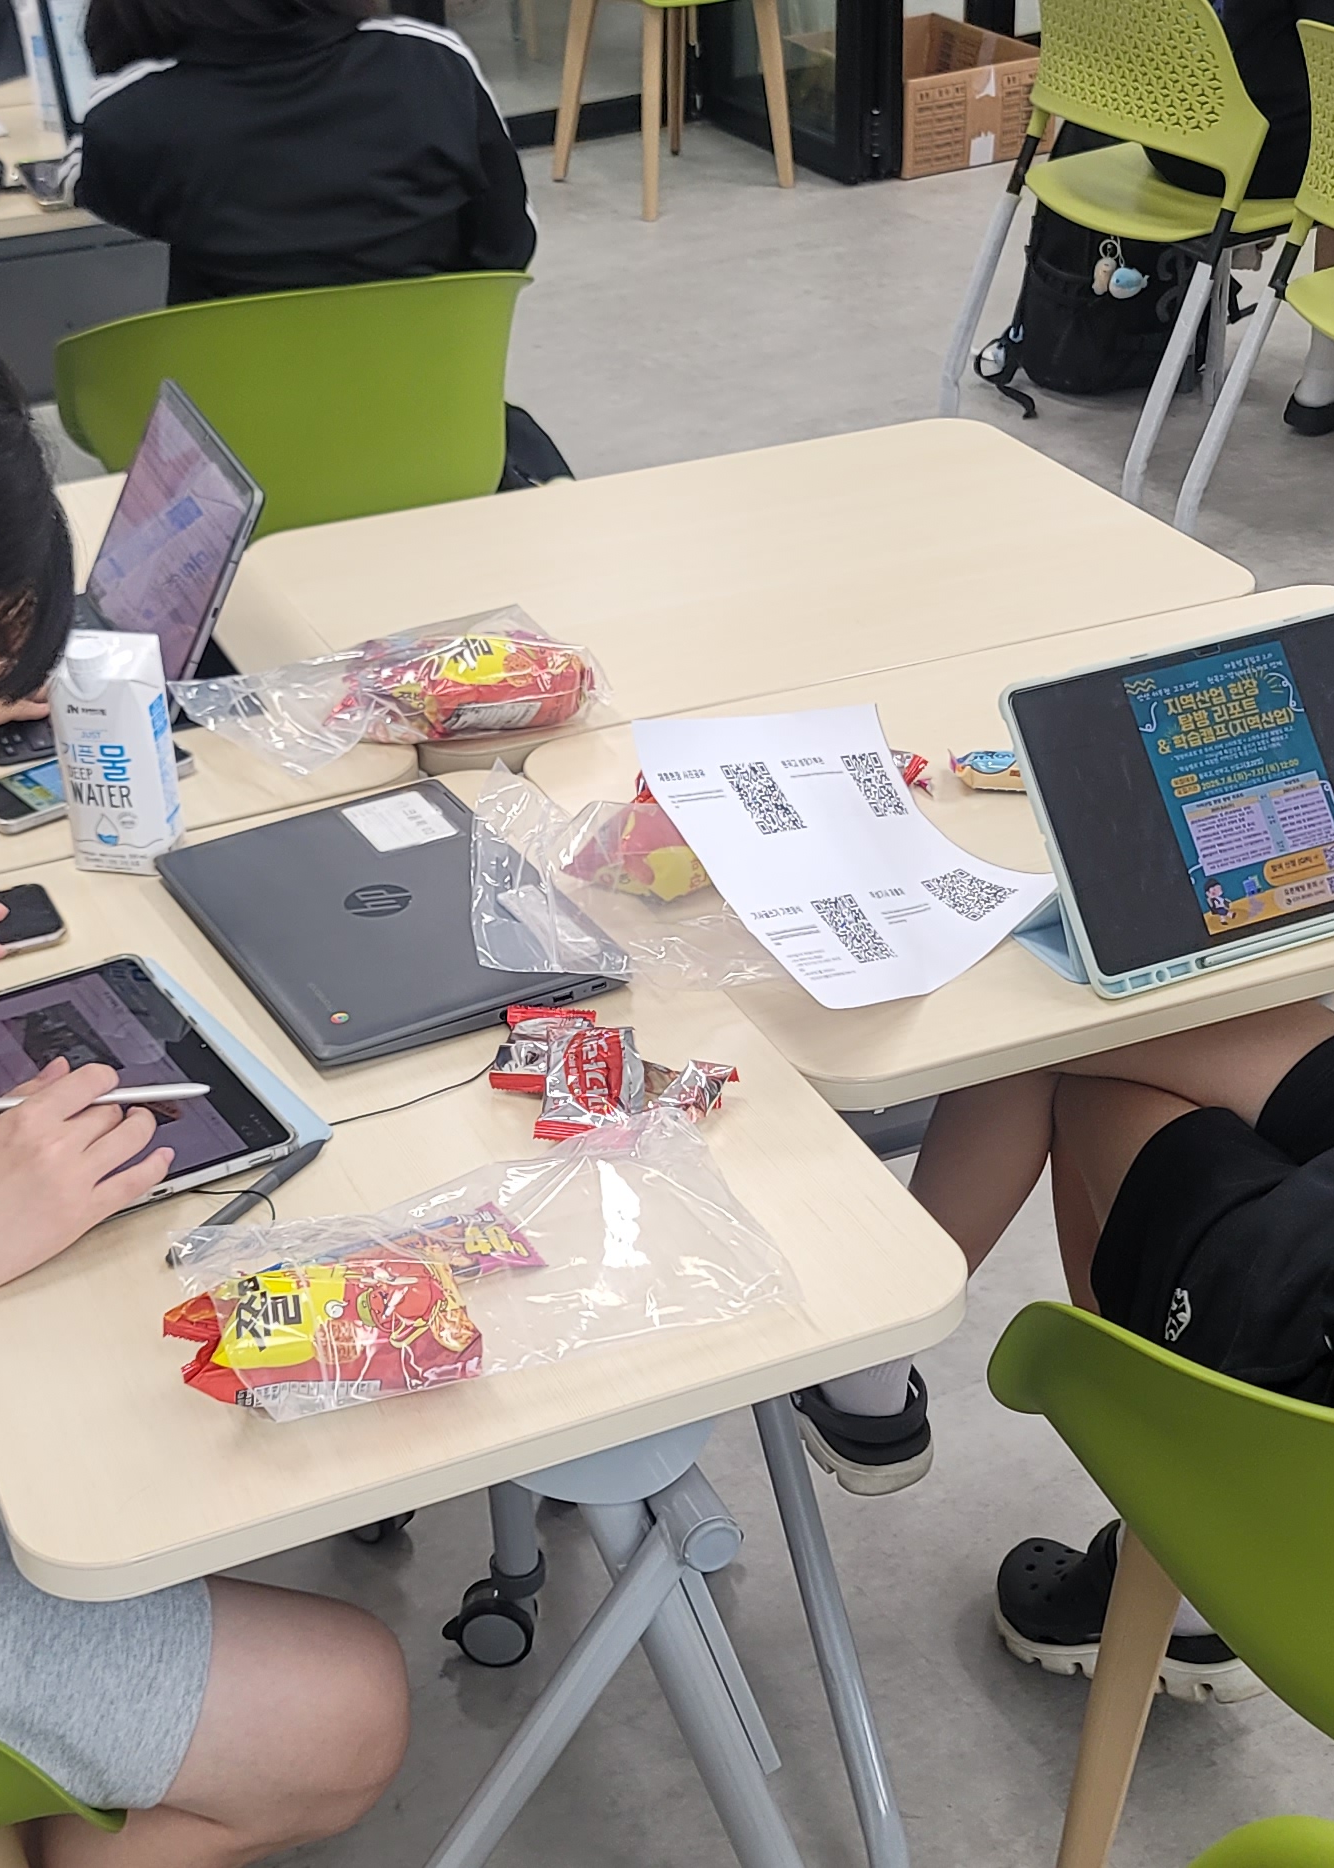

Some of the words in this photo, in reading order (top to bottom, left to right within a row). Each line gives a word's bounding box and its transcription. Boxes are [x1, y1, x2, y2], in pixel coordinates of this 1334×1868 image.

[1163, 686, 1227, 715] 지역산업
[1226, 679, 1260, 699] 현장
[1177, 707, 1210, 732] 탐방
[1210, 698, 1260, 724] 리포트
[1157, 740, 1172, 755] &
[1172, 706, 1295, 750] 학습캠프(지역산업)
[96, 744, 131, 782] 물
[70, 784, 133, 808] WATER
